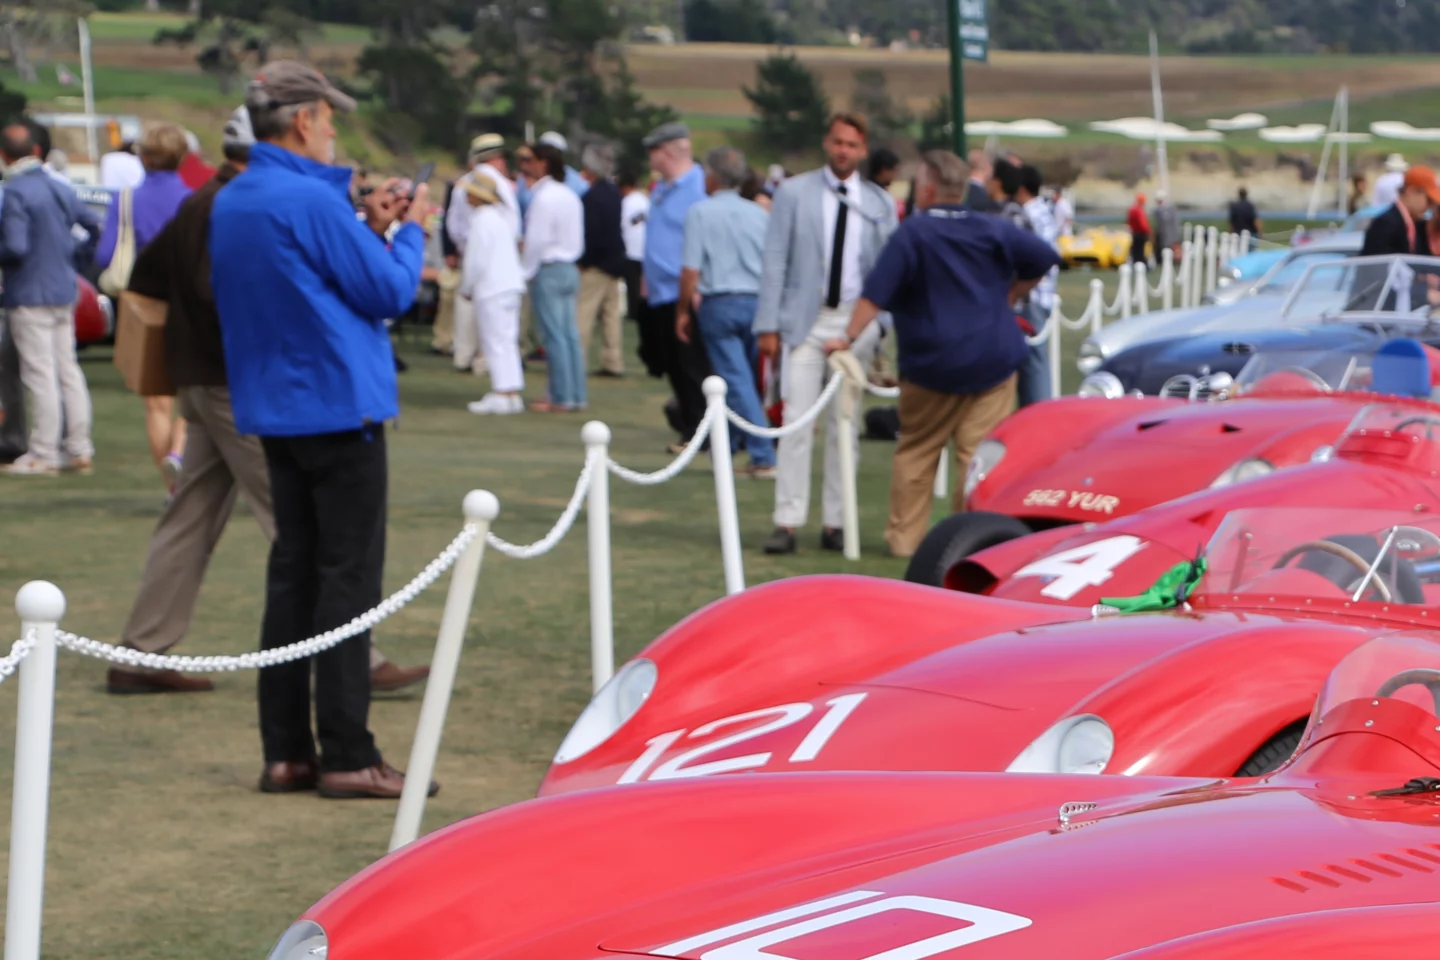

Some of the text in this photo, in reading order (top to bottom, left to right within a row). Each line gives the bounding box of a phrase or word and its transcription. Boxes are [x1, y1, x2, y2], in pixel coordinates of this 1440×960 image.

[1067, 490, 1120, 514] YUR
[1012, 534, 1149, 600] 4
[616, 692, 868, 784] 121
